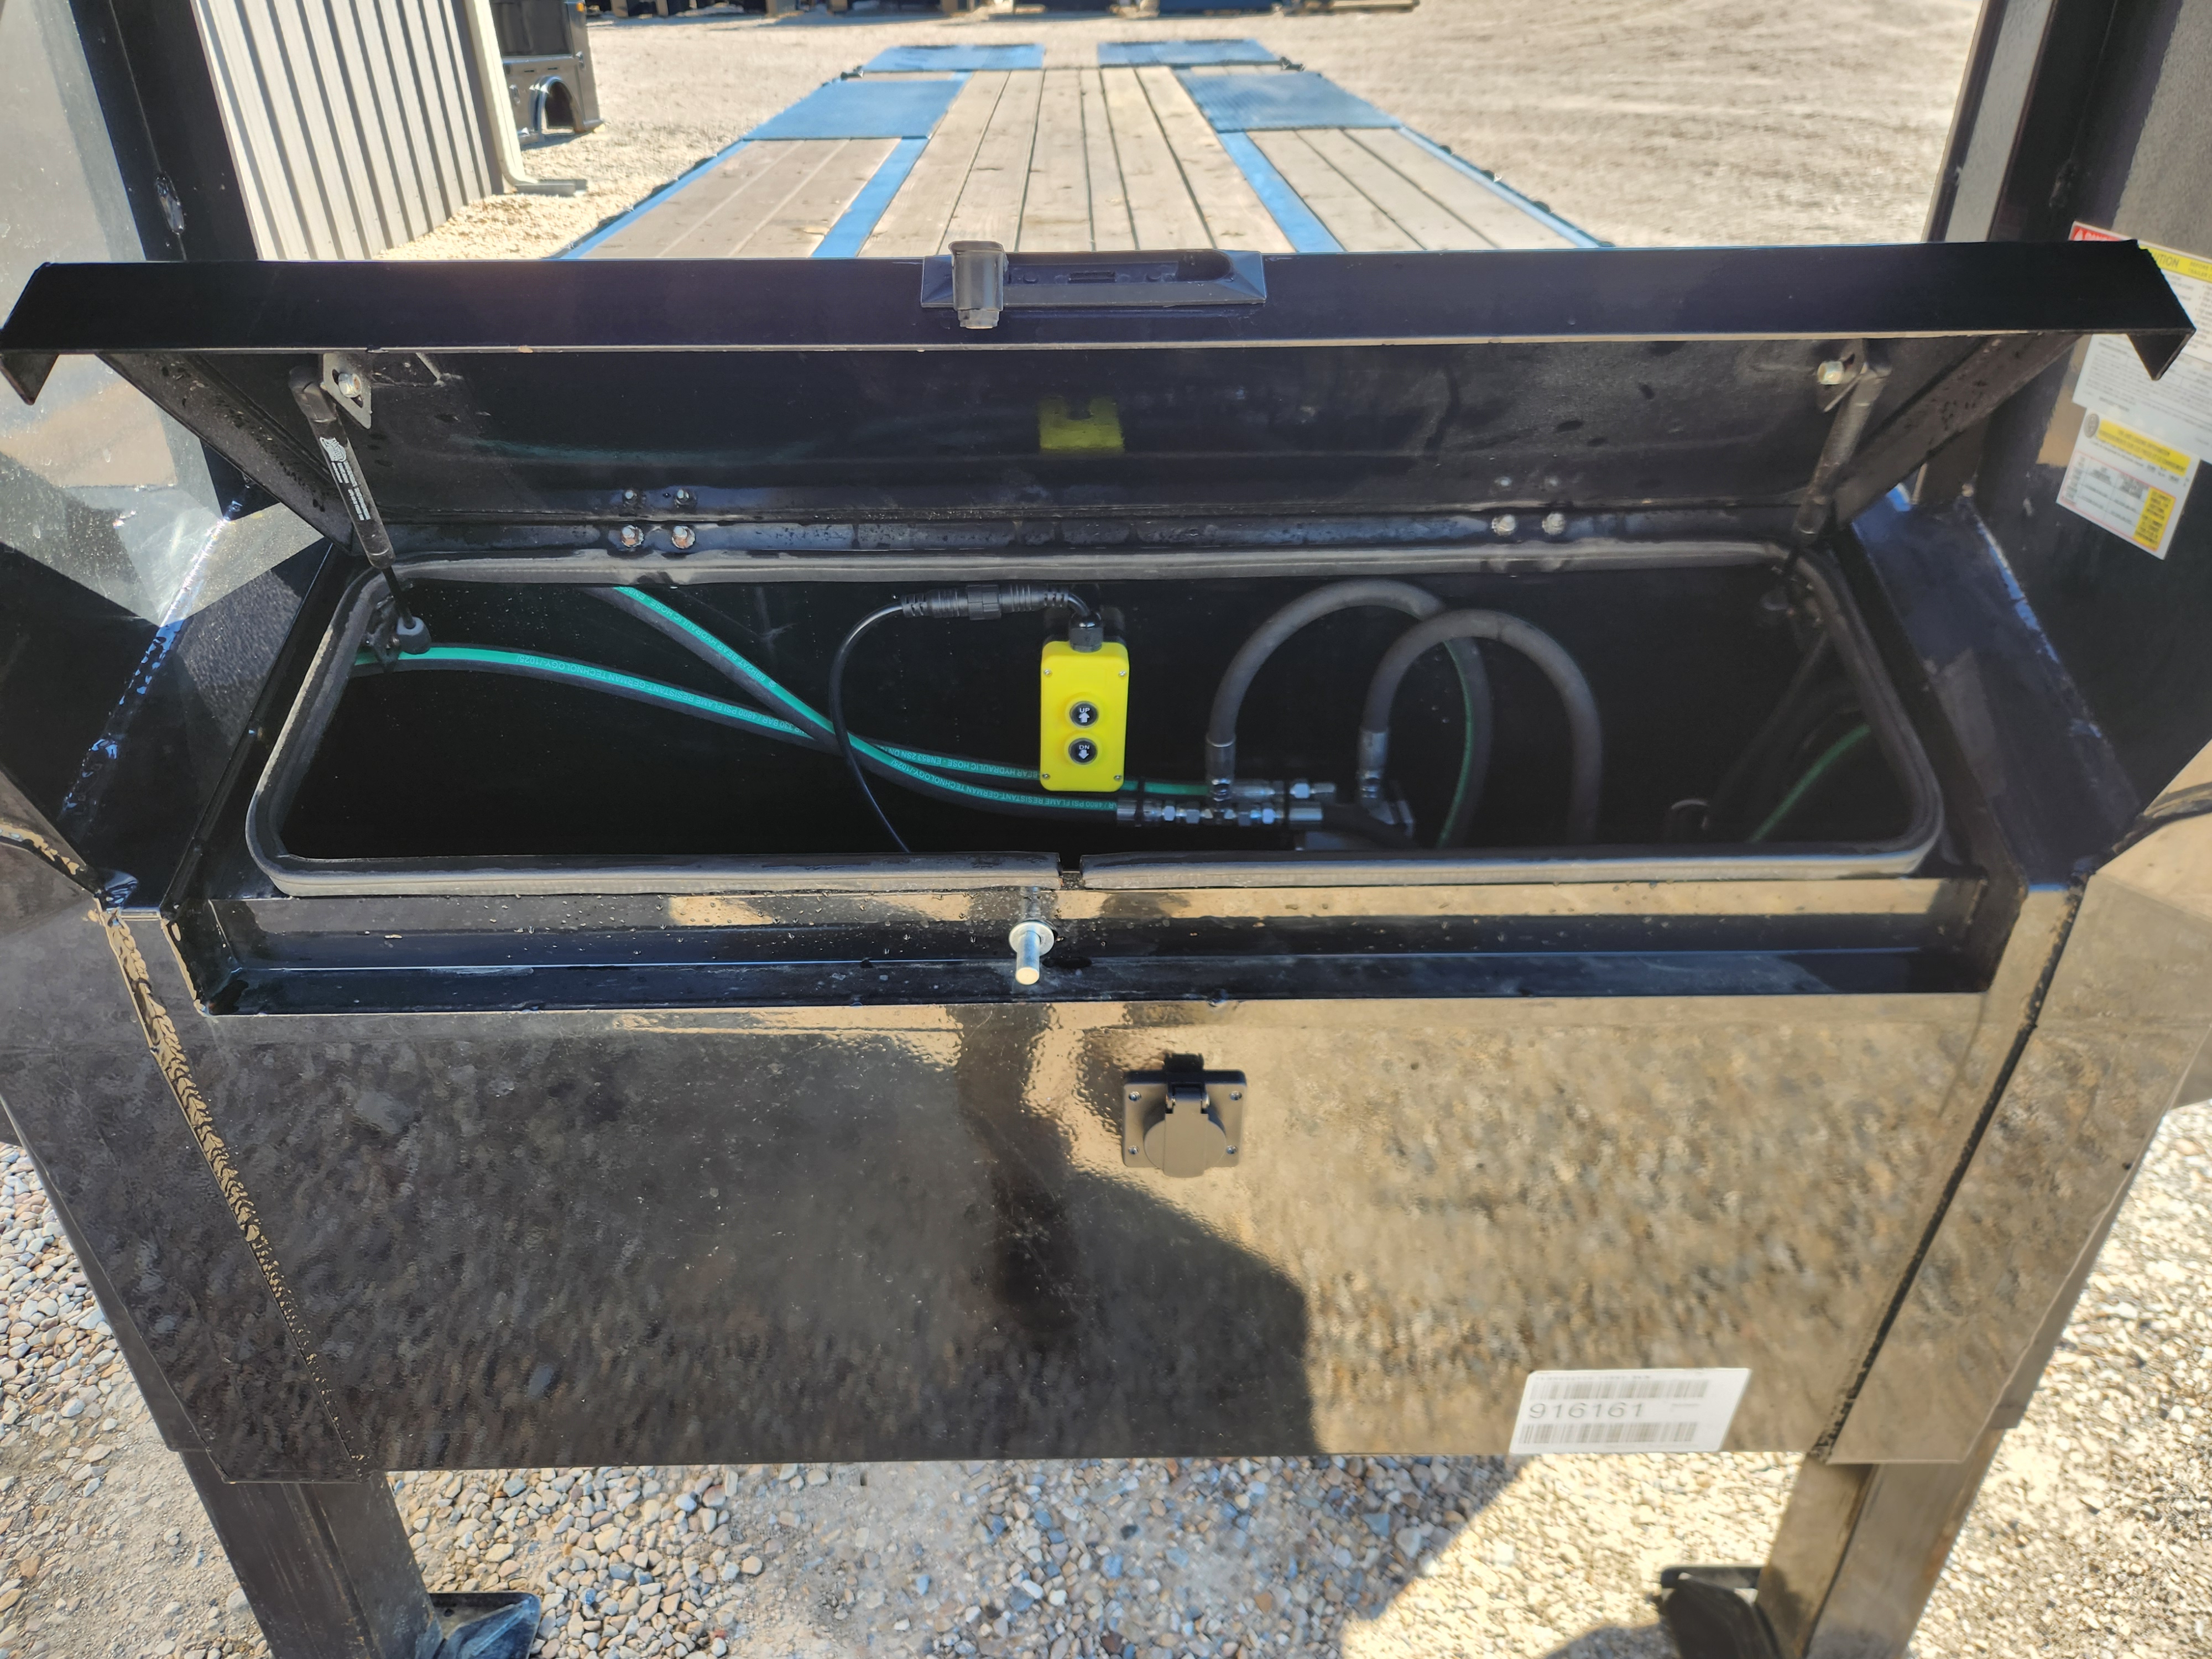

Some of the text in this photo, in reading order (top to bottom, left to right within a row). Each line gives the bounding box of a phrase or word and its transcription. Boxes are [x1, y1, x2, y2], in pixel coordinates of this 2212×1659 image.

[650, 599, 674, 617] HOSE
[674, 614, 717, 646] HYDRAULIC
[717, 643, 766, 681] 6BH2AT-BEAR
[608, 674, 694, 702] RESISTANT-GERMAN
[696, 697, 723, 711] FLAME
[724, 706, 737, 714] PSI
[739, 709, 757, 720] 4800
[762, 716, 779, 727] BAR
[780, 722, 794, 731] 330
[901, 751, 916, 760] 2SN
[917, 755, 942, 765] EN853
[947, 759, 969, 769] HOSE
[971, 763, 1016, 776] HYDRAULIC
[966, 786, 1044, 804] RESISTANT-GERMAN
[1045, 798, 1070, 806] FLAME
[1529, 1402, 1645, 1418] 916161
